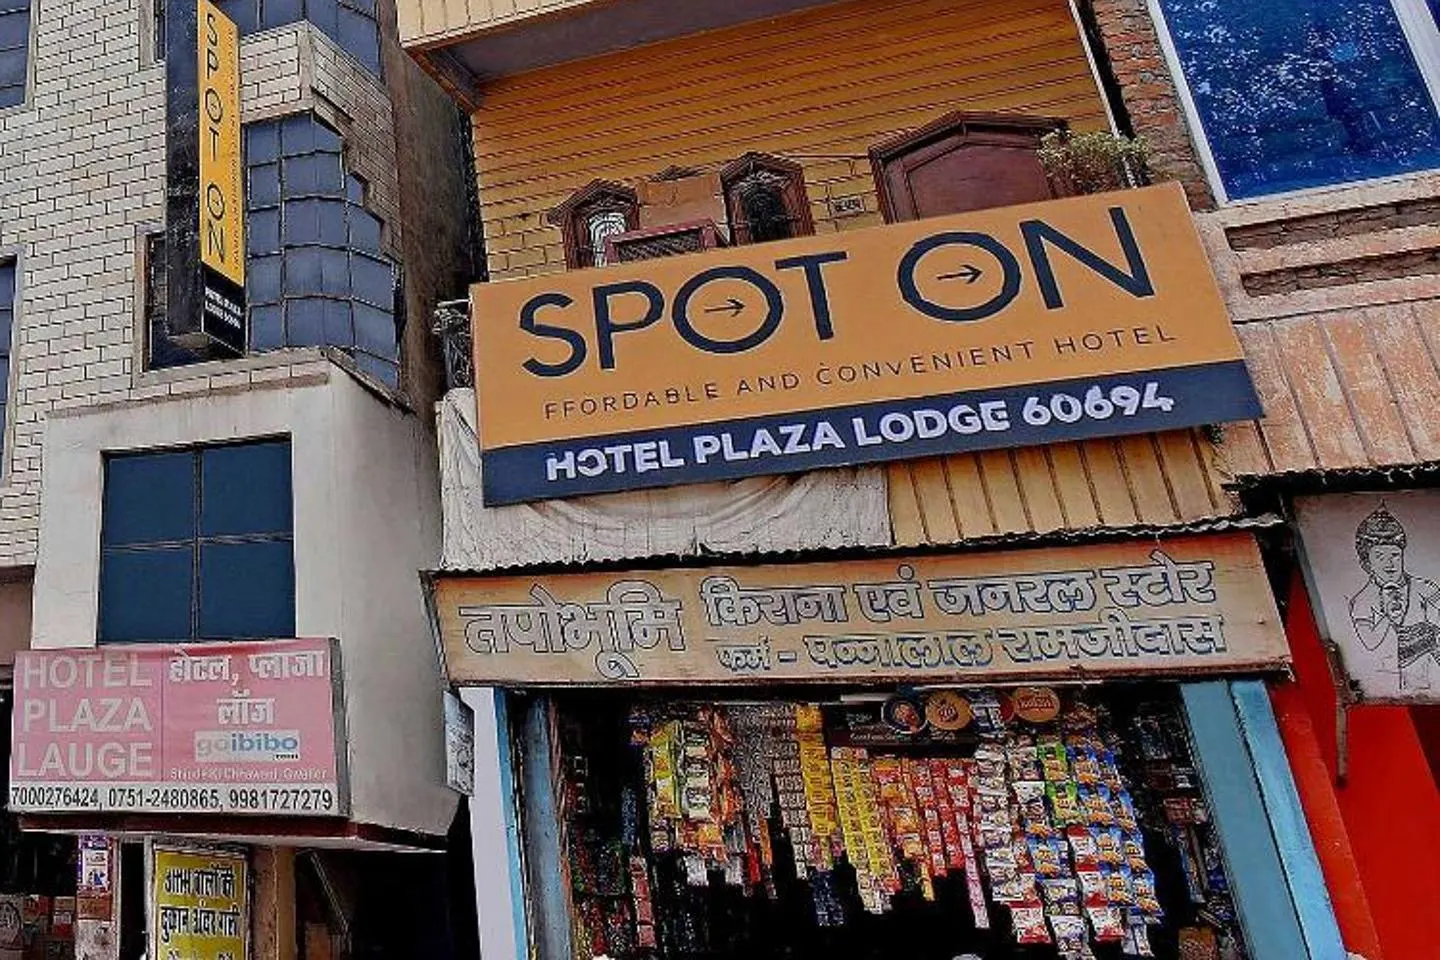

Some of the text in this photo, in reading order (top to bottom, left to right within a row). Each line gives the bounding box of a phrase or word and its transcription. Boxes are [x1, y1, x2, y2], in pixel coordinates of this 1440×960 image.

[205, 12, 226, 264] SPOT ON
[519, 206, 1155, 377] SPOT ON
[544, 324, 1177, 420] FFORDABLE AND CONVENIENT HOTEL
[545, 381, 1175, 482] HOTEL PLAZA LODGE 60694
[459, 550, 1216, 679] तपोभूमि किराना एवं जनरल स्टोर
[23, 653, 153, 690] HOTEL
[248, 650, 326, 680] प्लाजा
[23, 696, 153, 733] PLAZA
[17, 742, 153, 778] LAUGE
[196, 732, 299, 759] goibibo
[11, 786, 103, 810] 7000276424,
[228, 788, 334, 811] 9981727279
